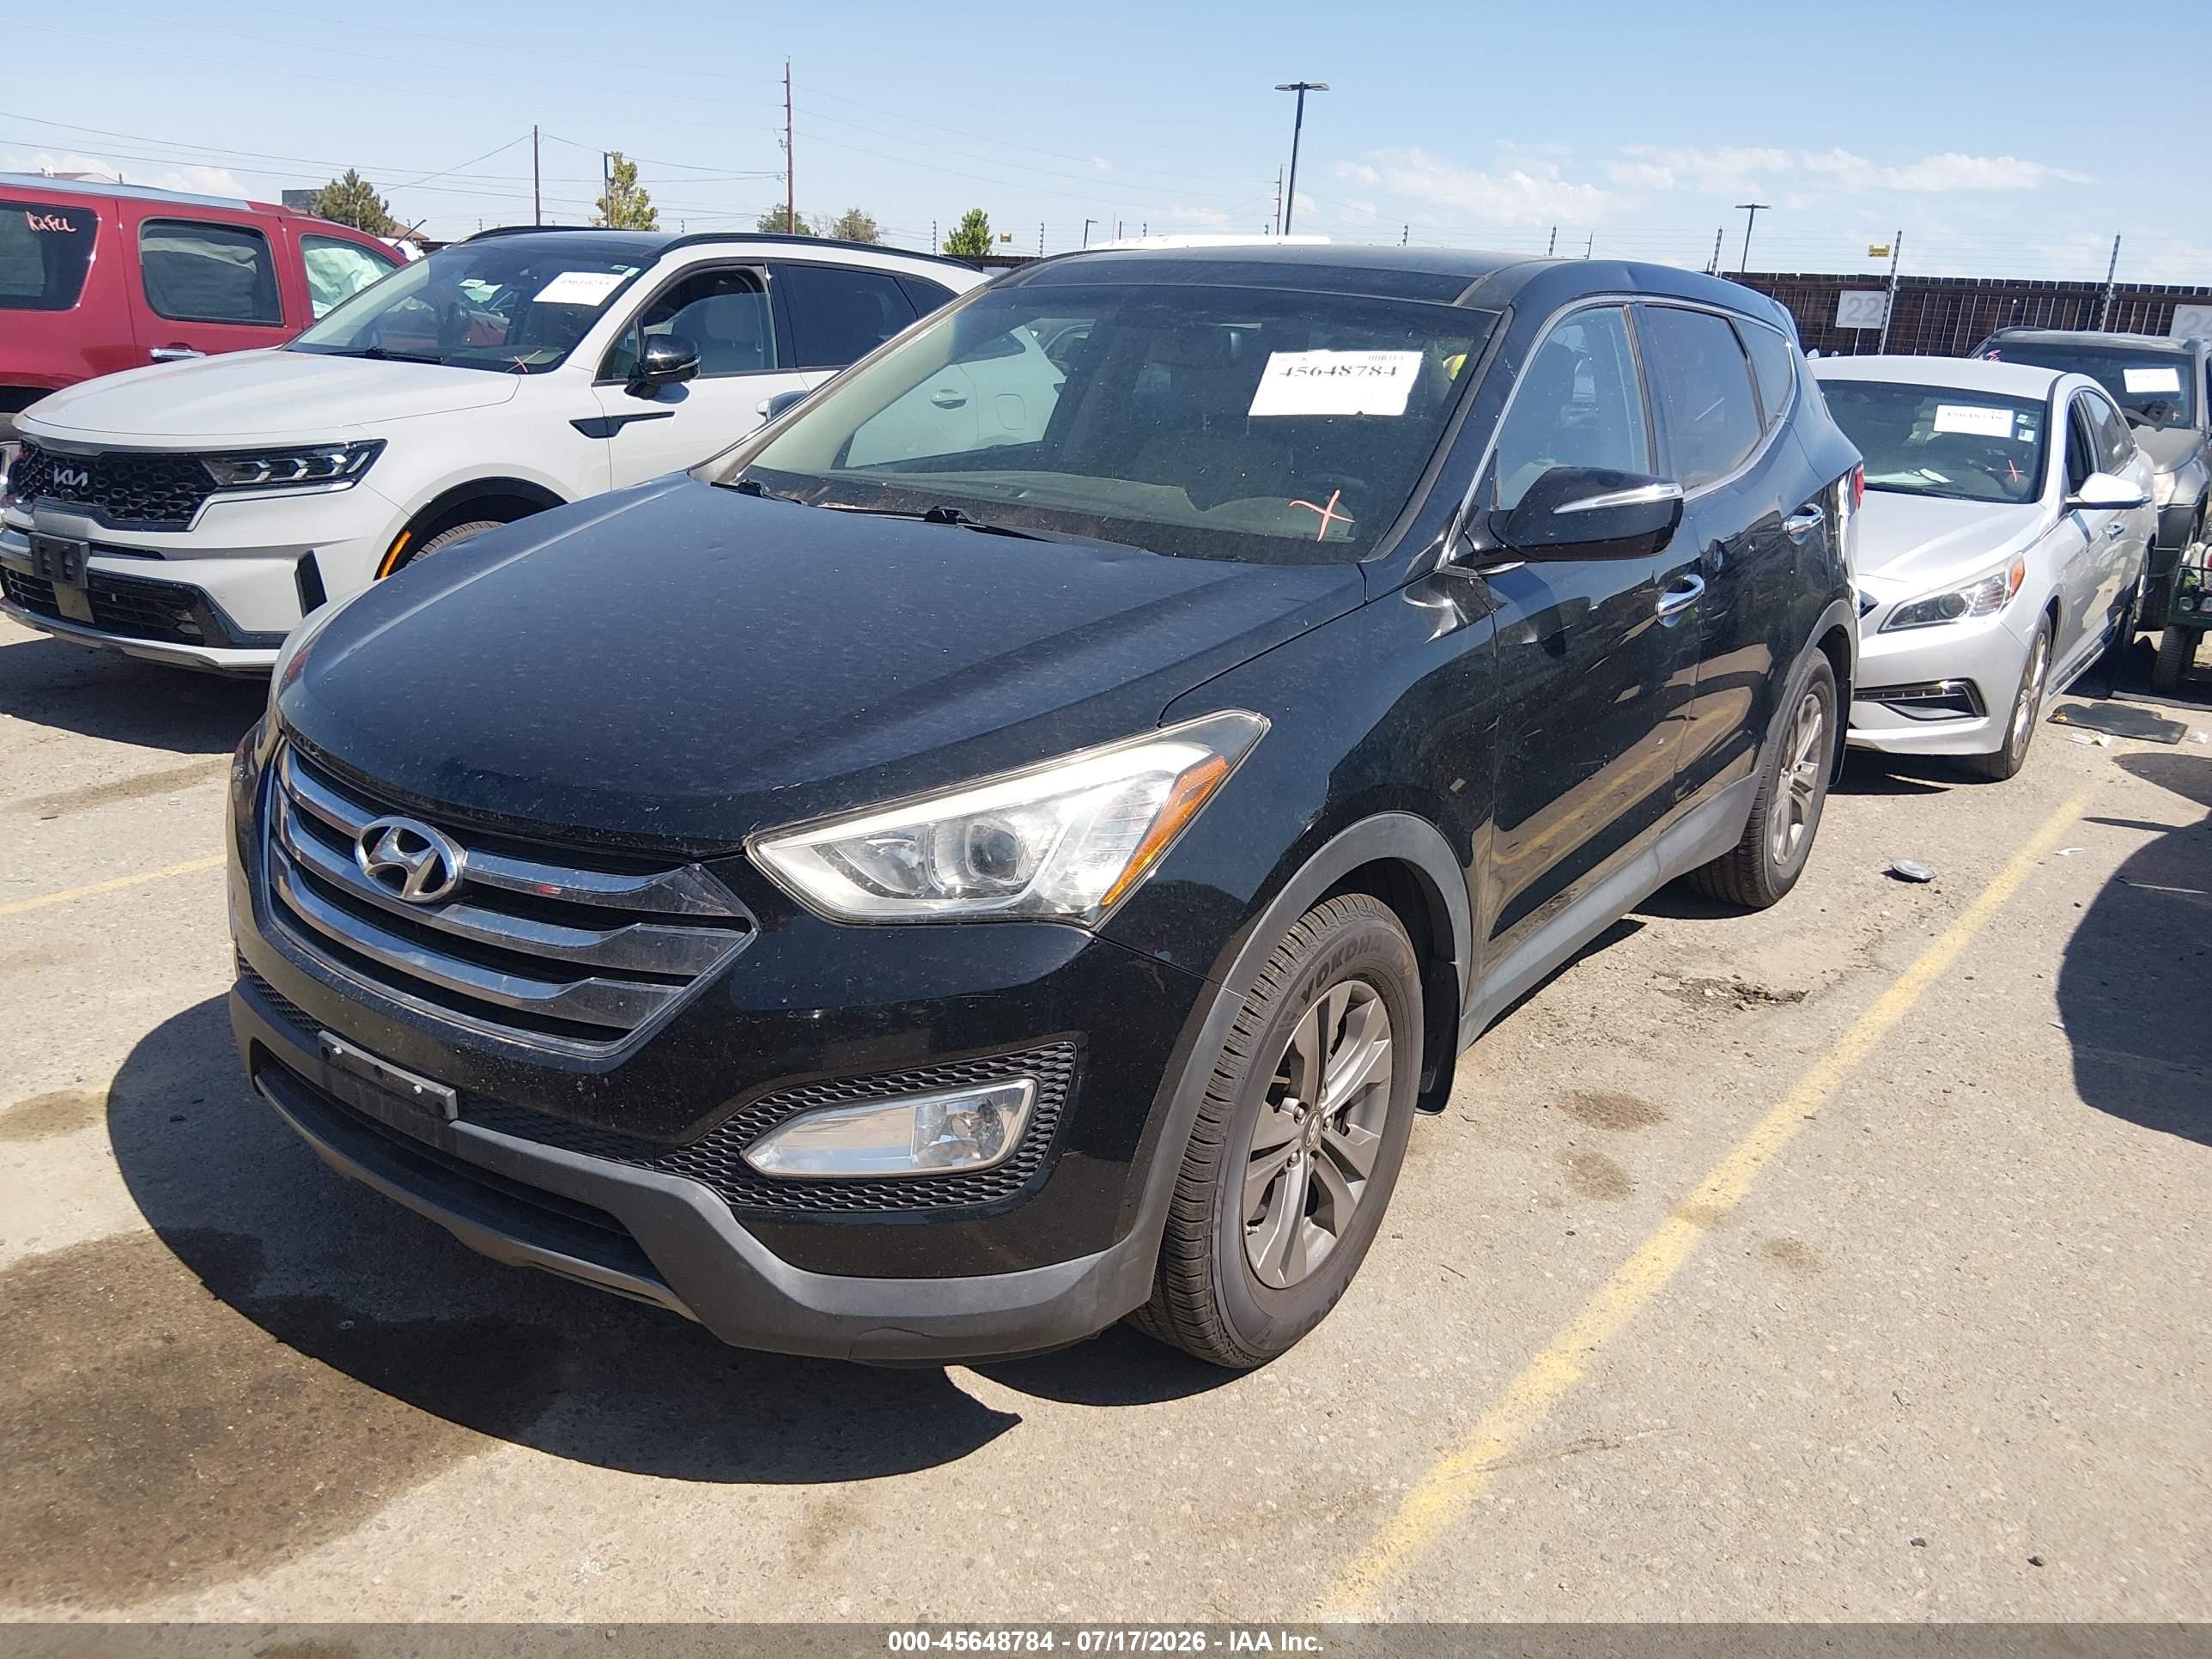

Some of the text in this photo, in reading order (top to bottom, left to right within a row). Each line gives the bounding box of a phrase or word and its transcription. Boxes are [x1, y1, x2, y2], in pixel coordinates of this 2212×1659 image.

[1844, 296, 1881, 323] 22
[1278, 365, 1398, 377] 45648784
[1300, 933, 1406, 1006] YOKOHA
